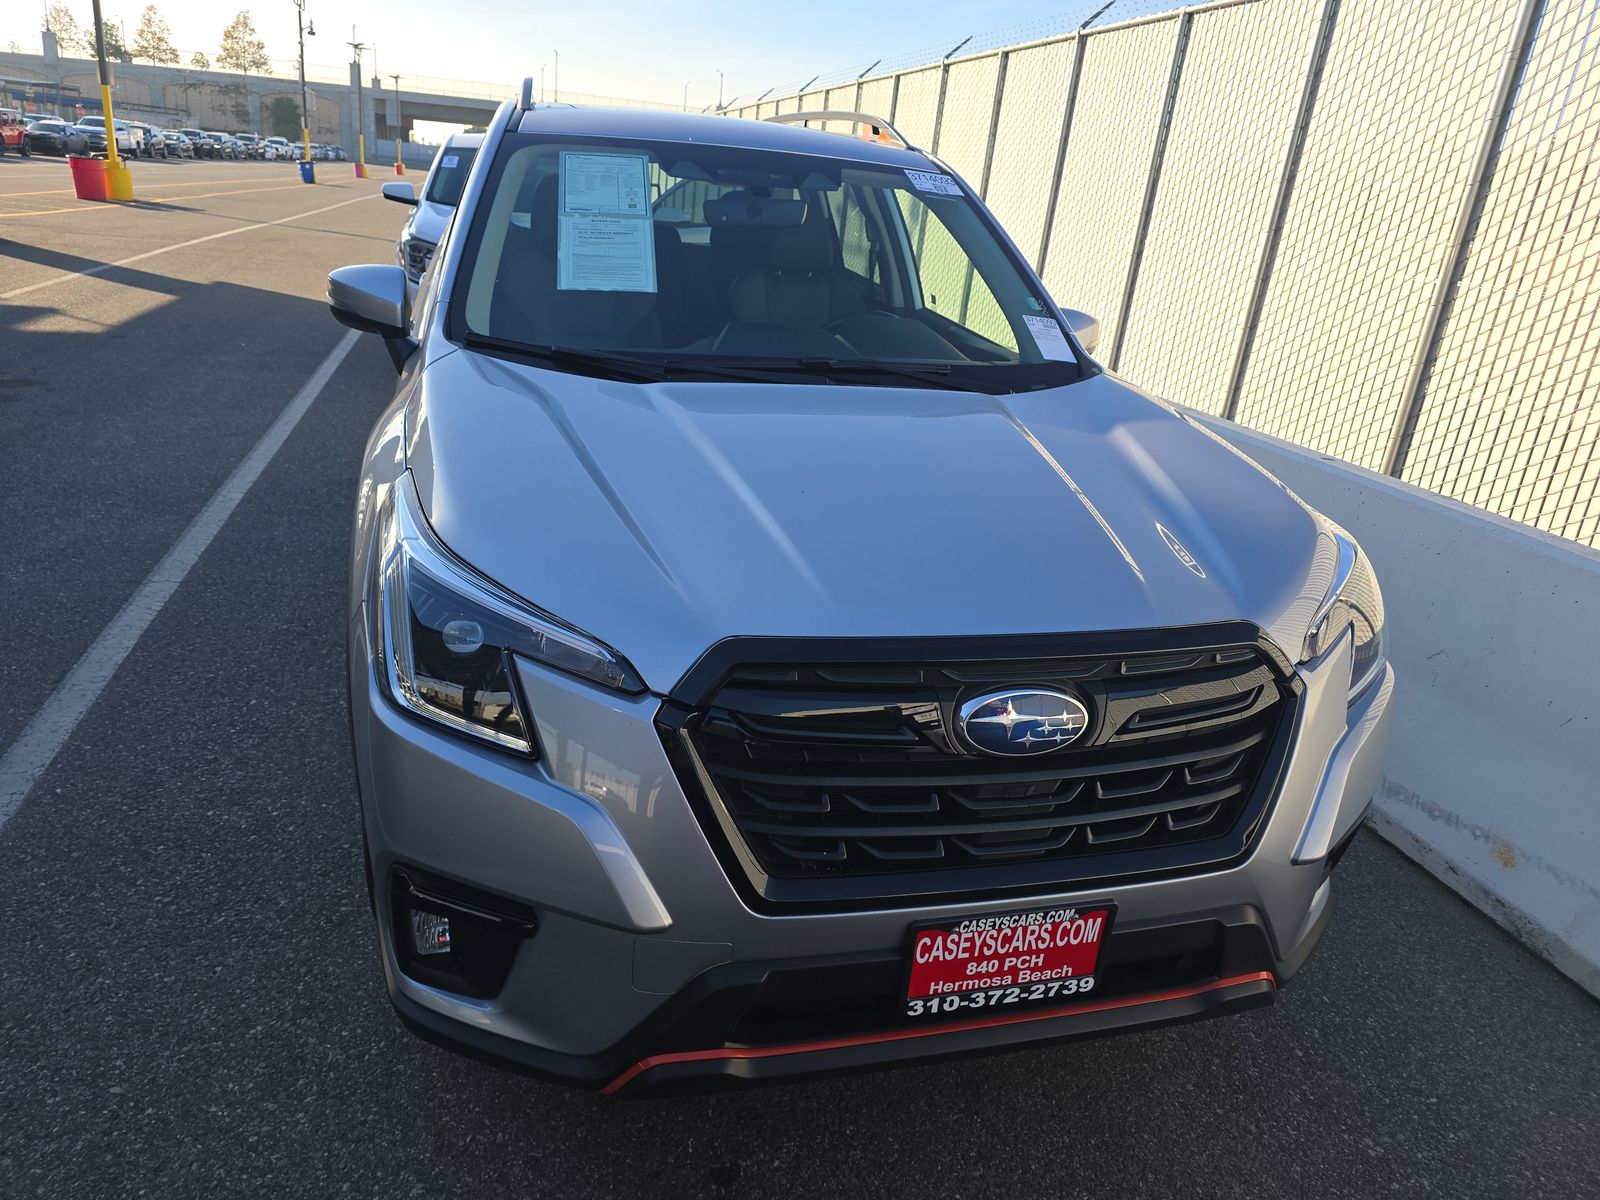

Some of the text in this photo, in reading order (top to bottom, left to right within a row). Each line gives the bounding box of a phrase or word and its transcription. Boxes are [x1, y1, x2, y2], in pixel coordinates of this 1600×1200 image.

[959, 908, 1076, 934] CASEYSCARS.COM
[915, 917, 1102, 964] CASEYSCARS.COM
[966, 953, 1045, 976] 840 PCH
[929, 965, 1073, 995] Hermosa Beach
[907, 977, 1095, 1016] 310-372-2739
